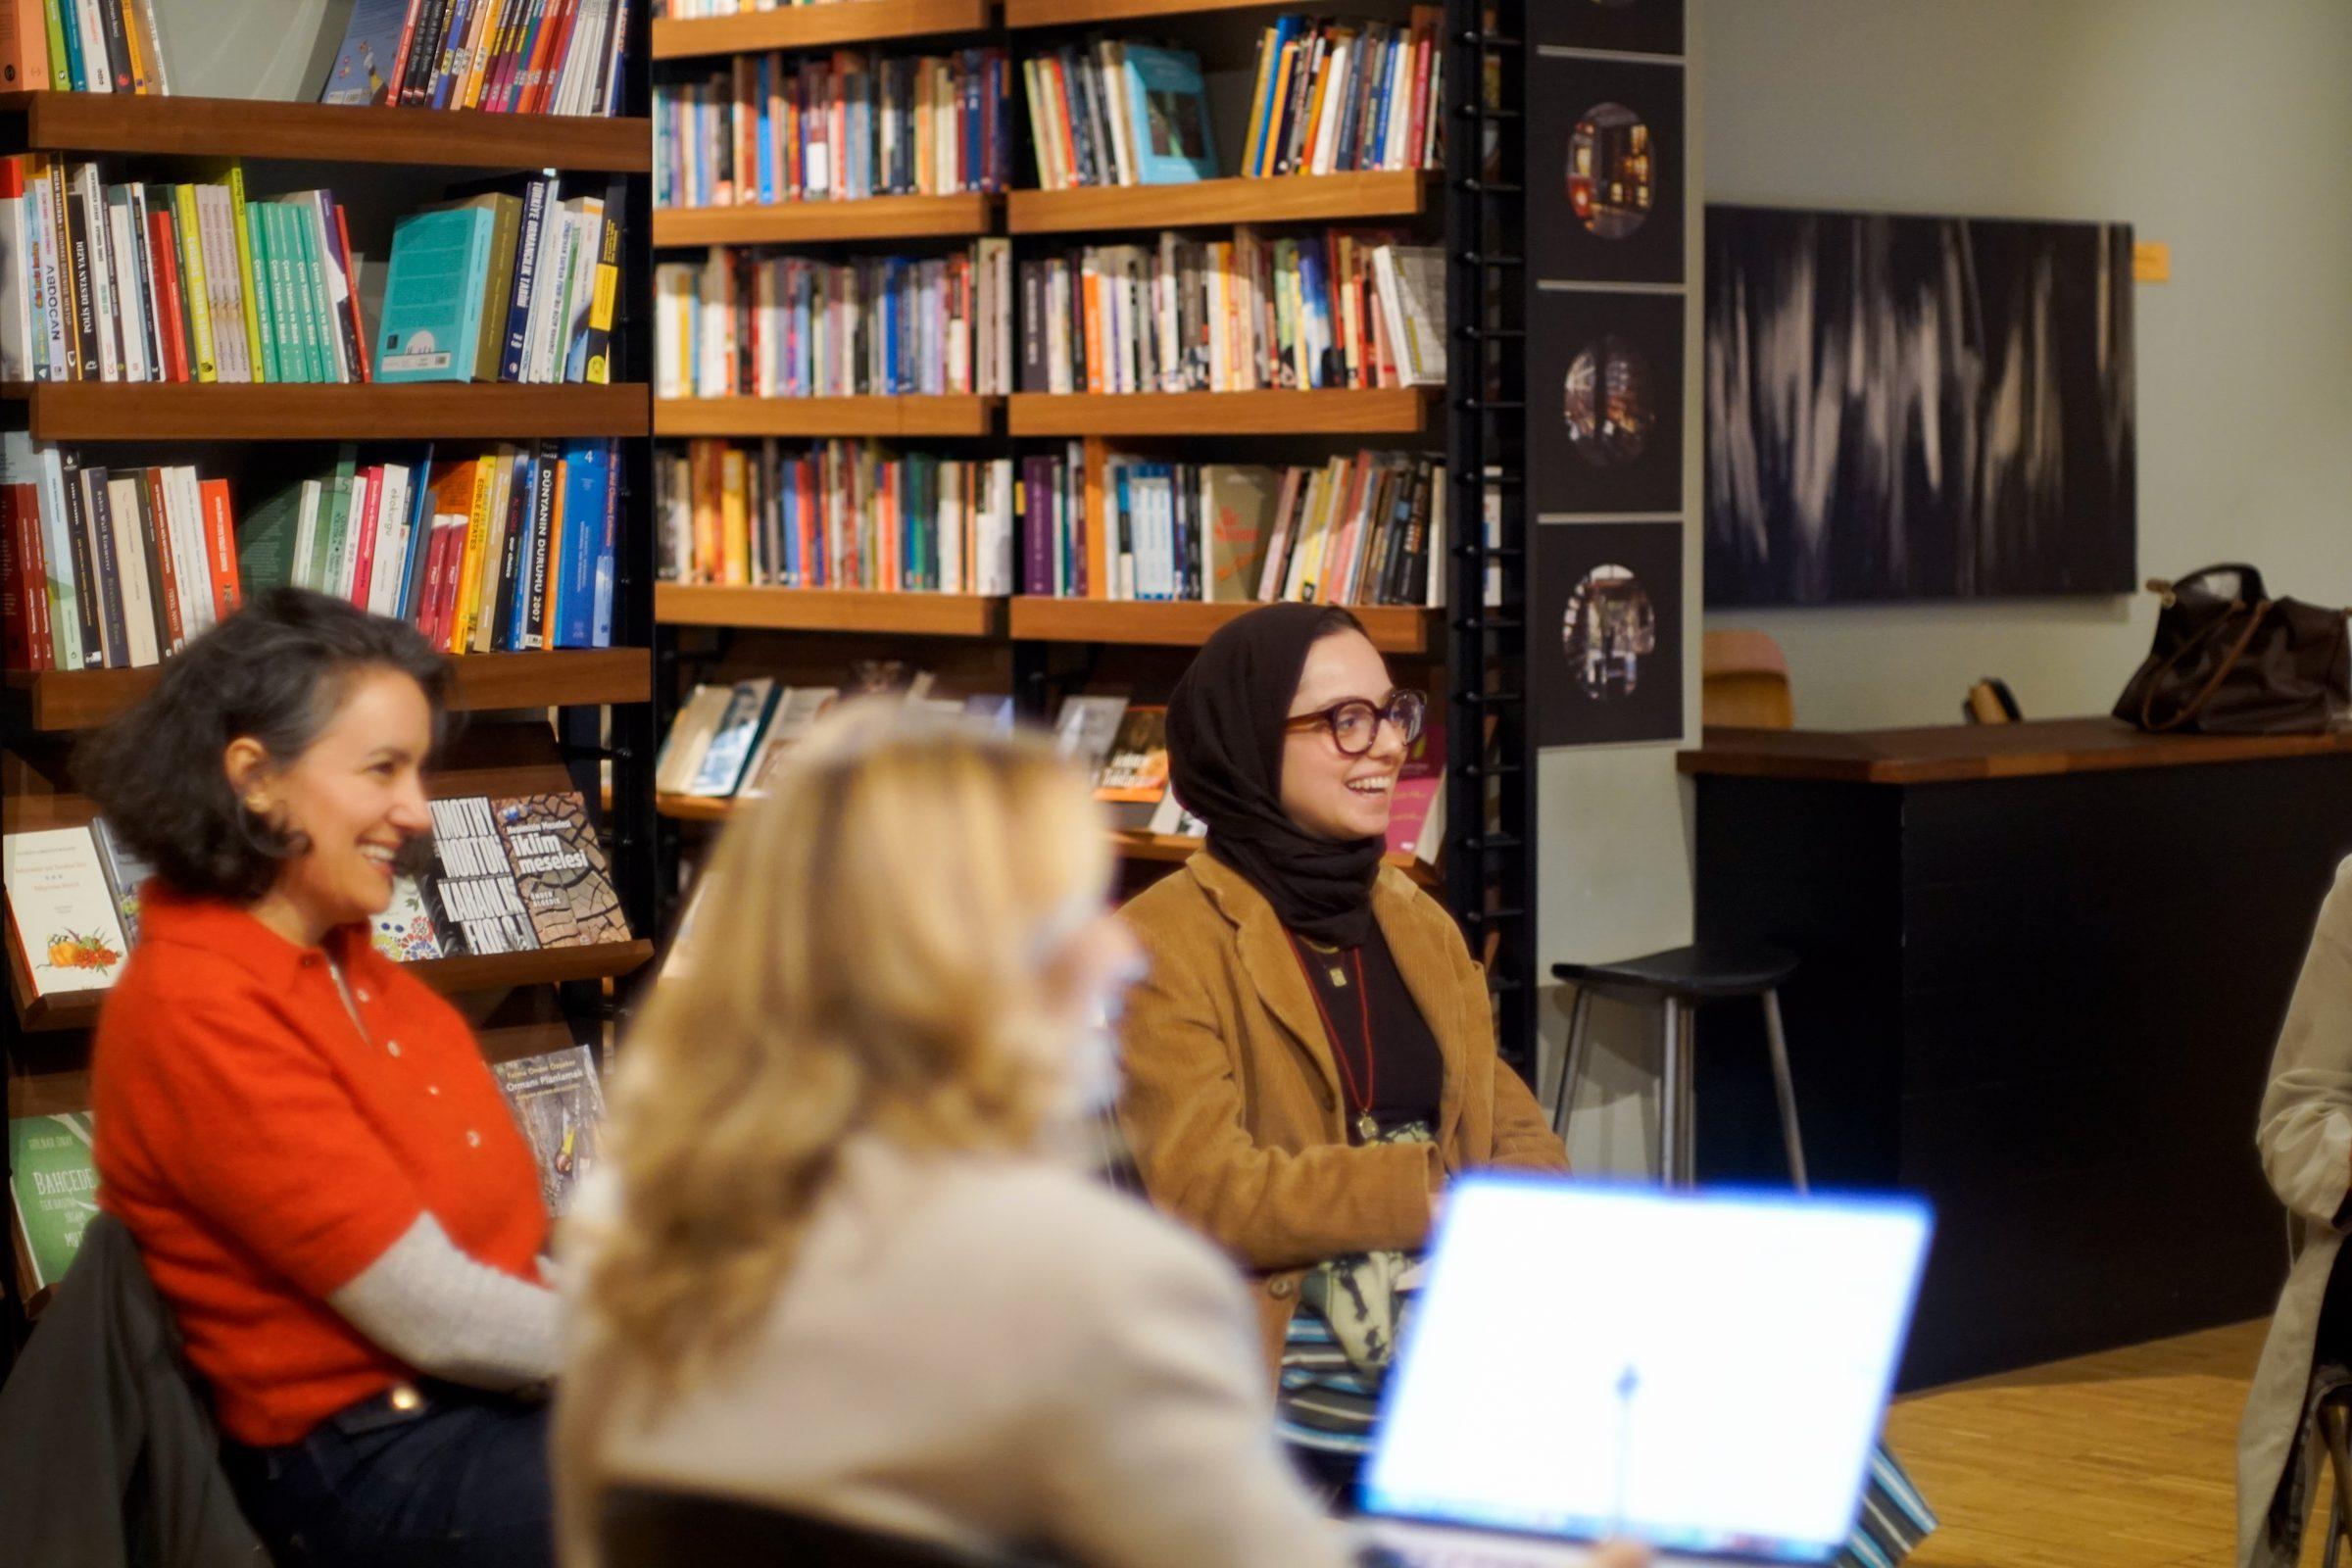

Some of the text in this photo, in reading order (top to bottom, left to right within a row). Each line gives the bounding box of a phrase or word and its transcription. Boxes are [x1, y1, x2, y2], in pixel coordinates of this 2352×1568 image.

[515, 181, 545, 308] TÜRKİYE ORMANCILIK TARİHİ
[75, 241, 92, 333] POLİS DESTAN YAZDI
[585, 449, 594, 464] 4
[475, 478, 484, 510] EDIBLE
[537, 469, 553, 536] DÜNYANIN
[99, 514, 108, 532] Wall
[469, 513, 479, 550] ESTATES
[534, 539, 546, 593] DURUMU
[531, 595, 542, 622] 2007
[510, 832, 563, 858] iklim
[517, 850, 589, 875] meselesi
[540, 1068, 583, 1086] Planlamak
